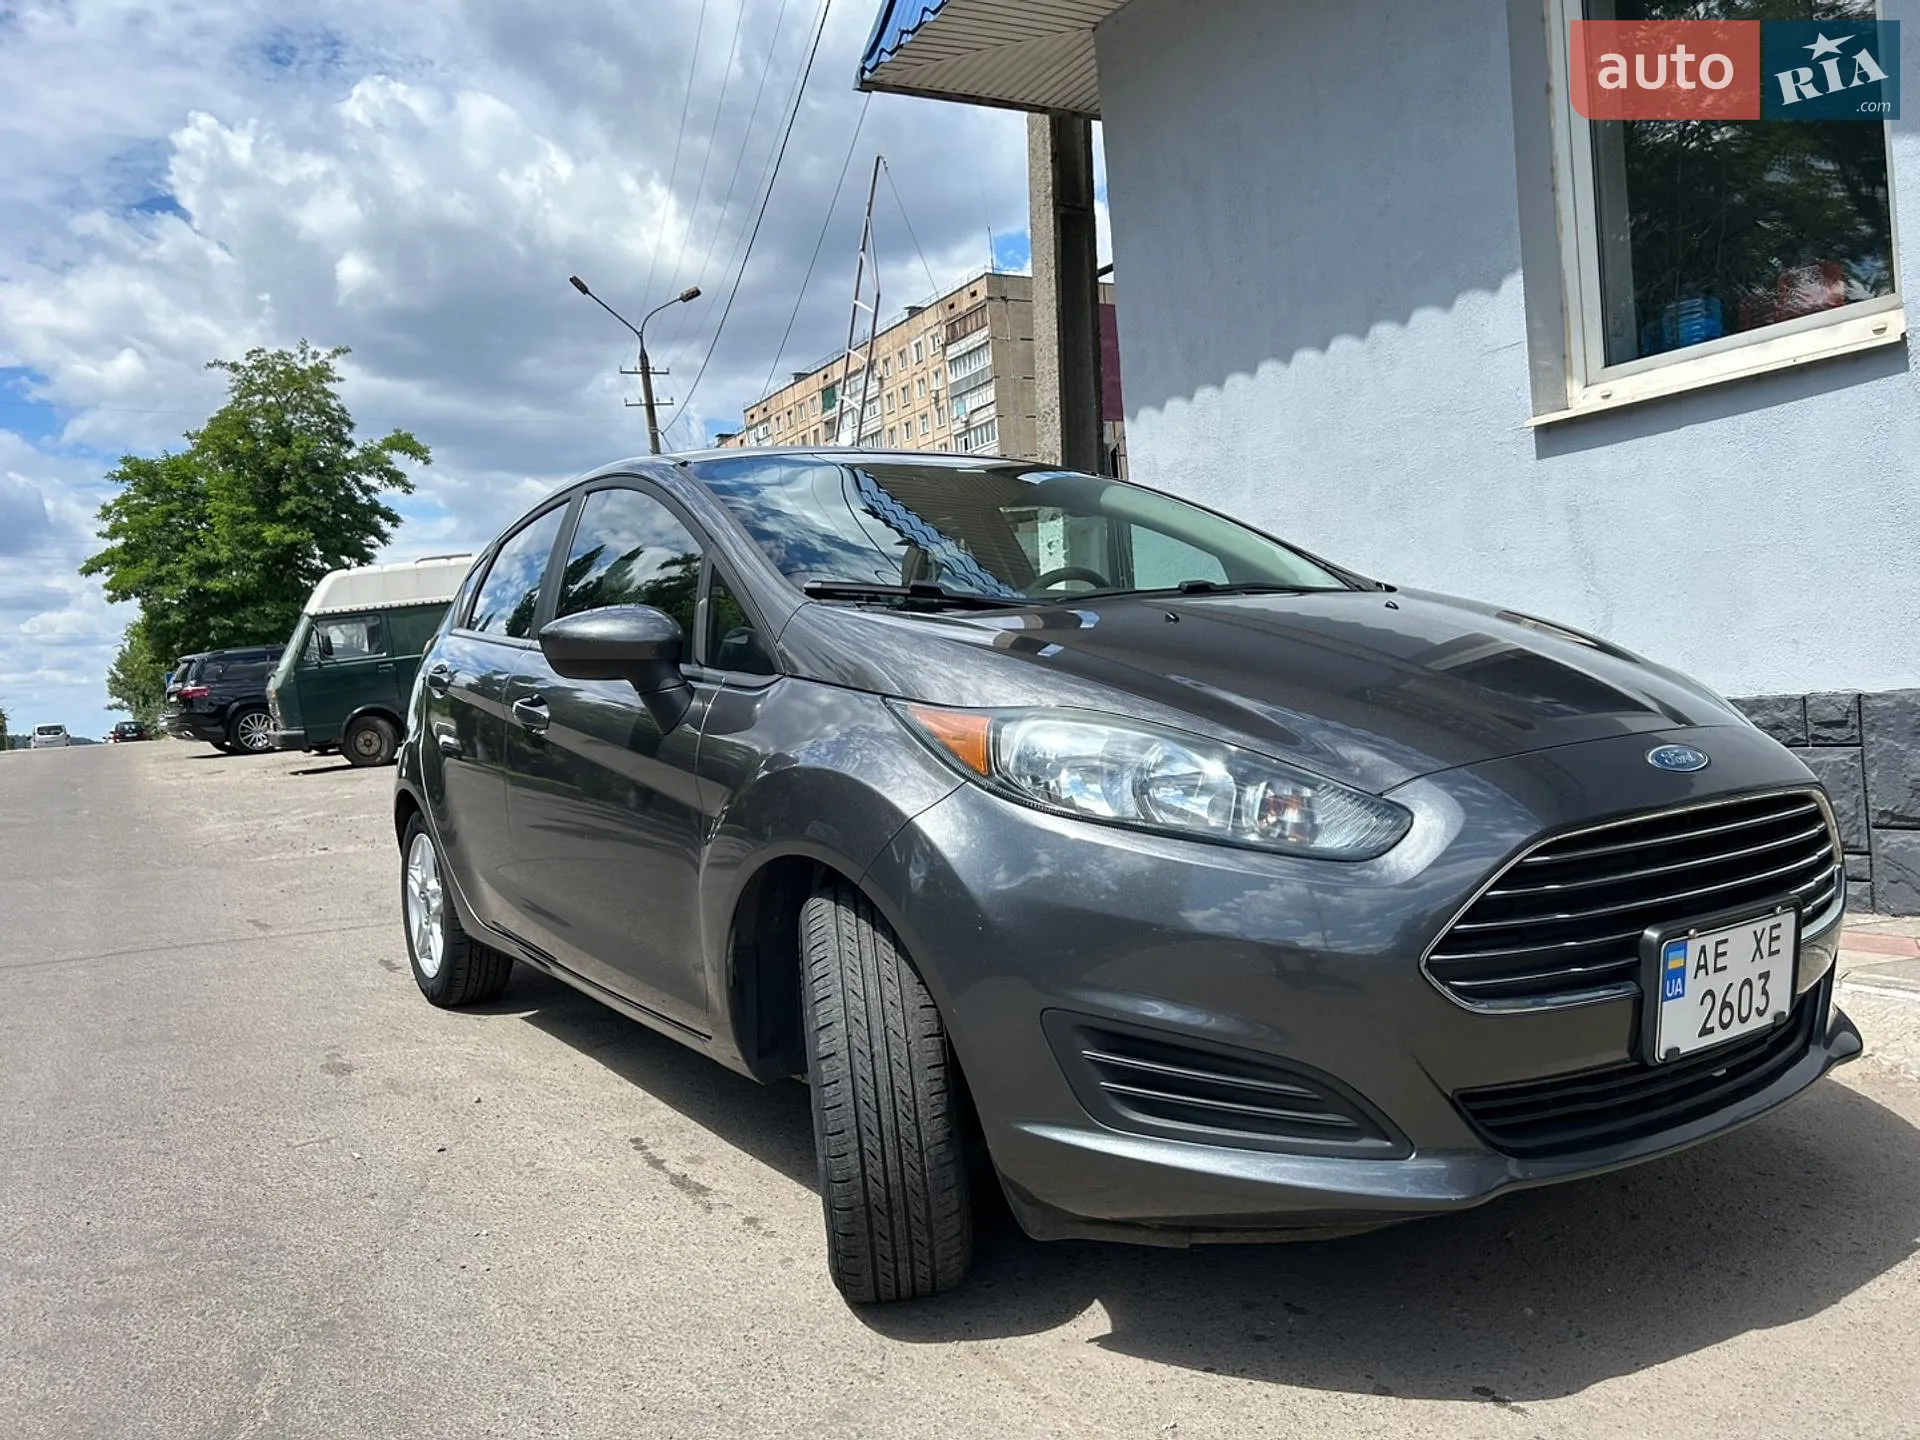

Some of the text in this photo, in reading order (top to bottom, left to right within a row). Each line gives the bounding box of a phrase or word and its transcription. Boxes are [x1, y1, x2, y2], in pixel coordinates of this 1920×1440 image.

[1660, 749, 1696, 766] Ford
[1693, 922, 1782, 980] AE XE
[1666, 978, 1683, 997] UA
[1698, 970, 1771, 1039] 2603
